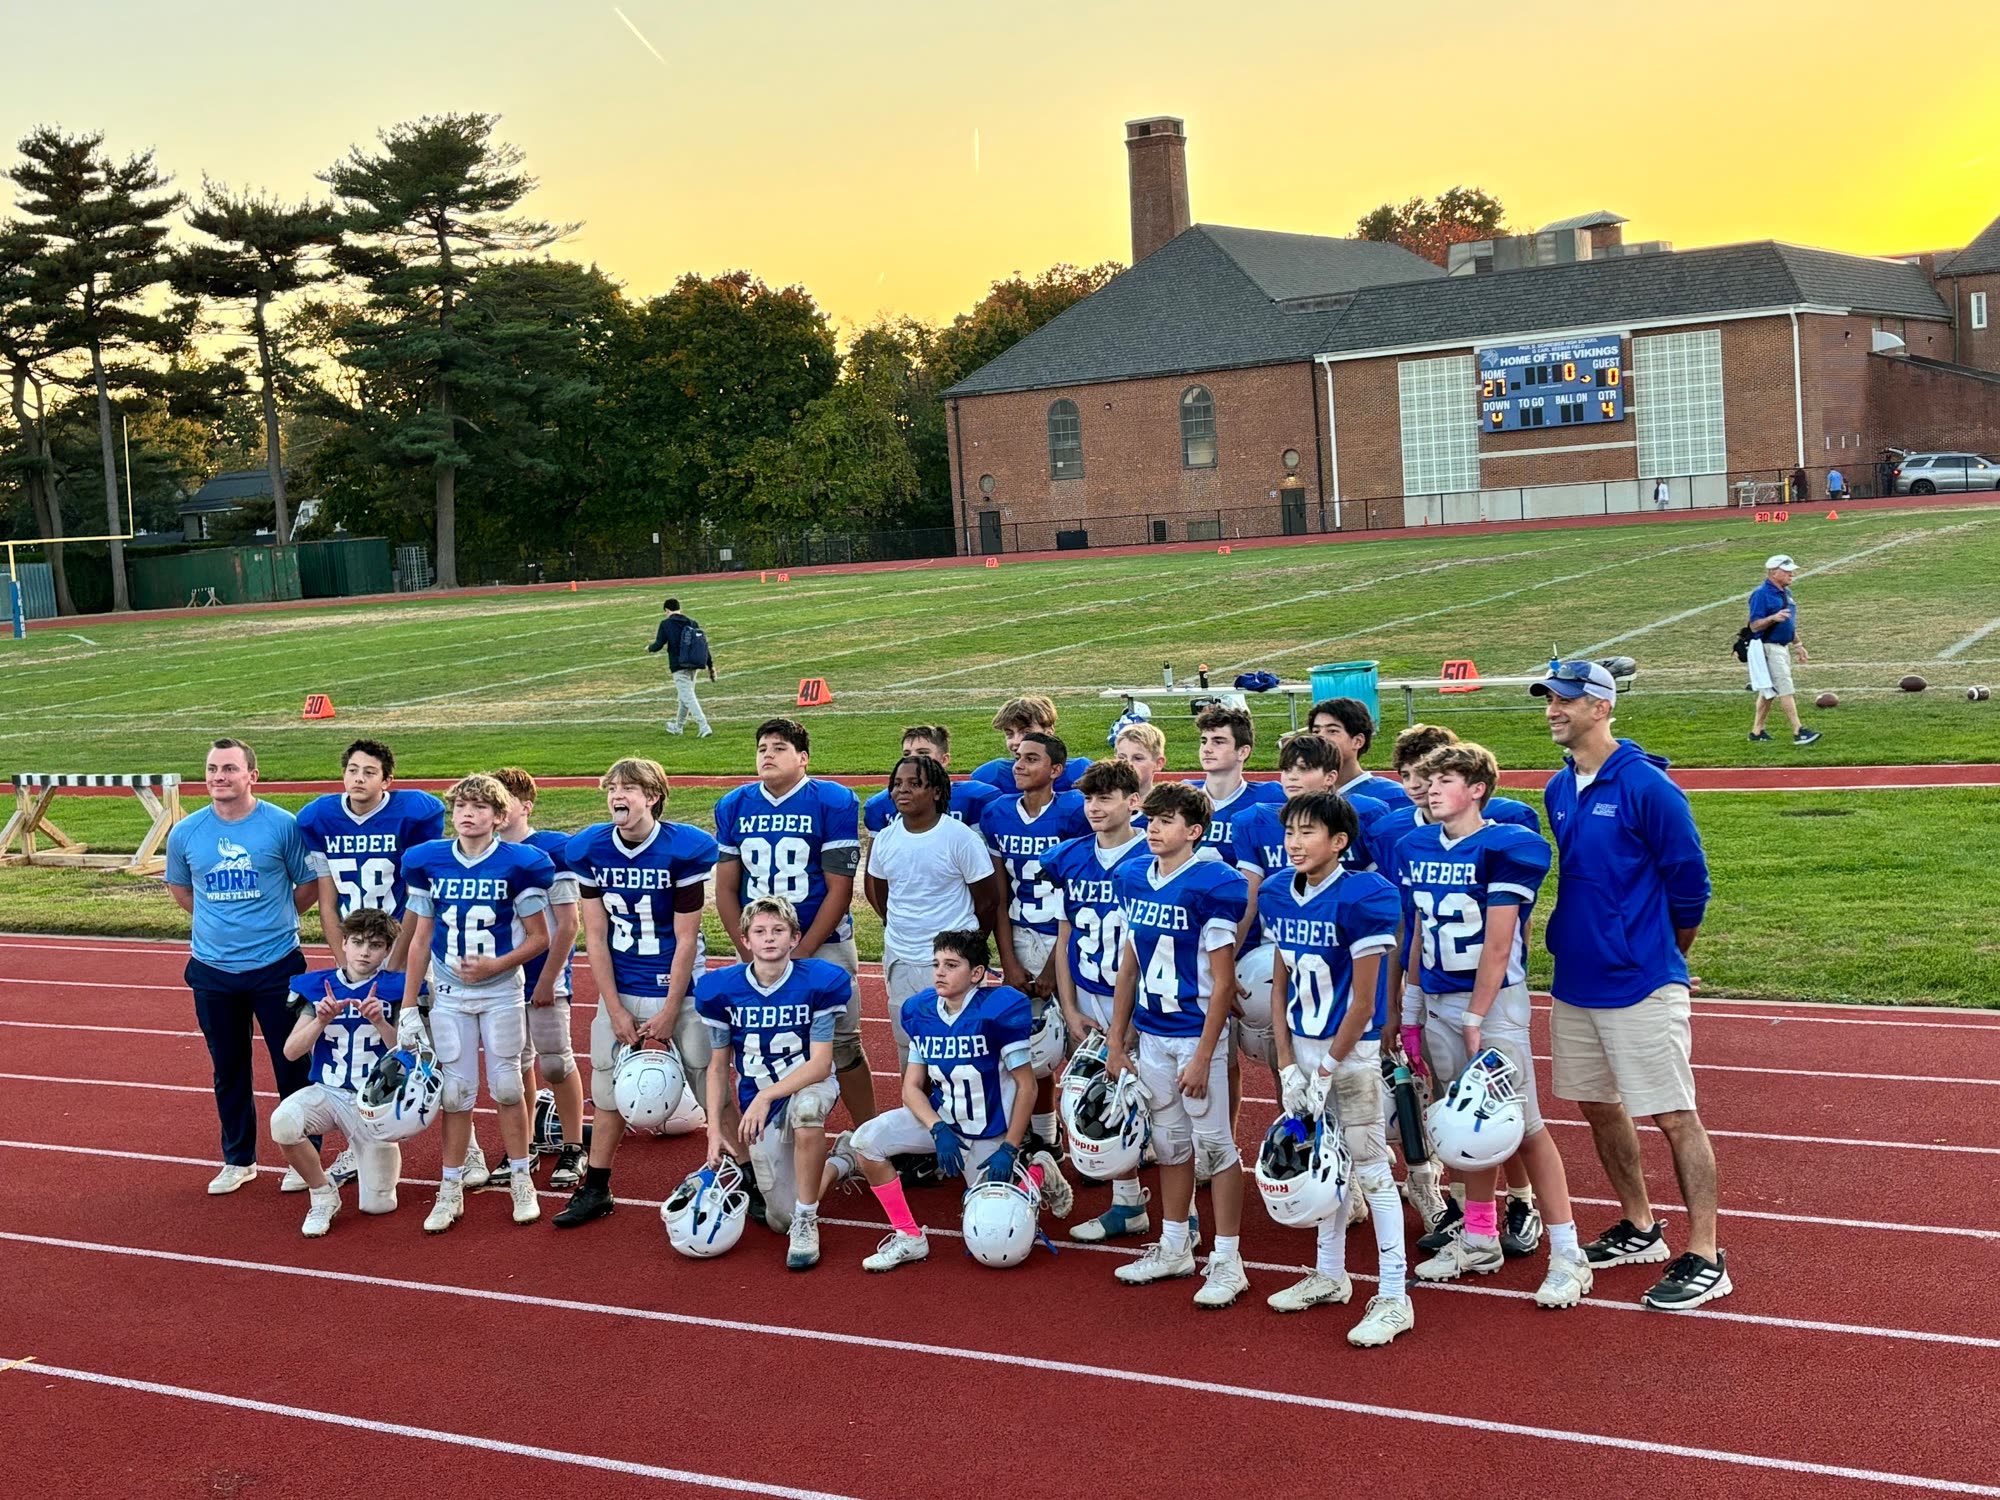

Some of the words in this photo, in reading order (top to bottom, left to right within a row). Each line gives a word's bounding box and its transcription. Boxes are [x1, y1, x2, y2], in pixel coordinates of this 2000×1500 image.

[1500, 355, 1531, 366] HOME
[1533, 353, 1547, 363] OF
[1549, 350, 1571, 361] THE
[1573, 346, 1619, 359] VIKINGS
[1592, 357, 1620, 369] GUEST
[1481, 369, 1507, 380] HOME
[1564, 362, 1576, 381] 0
[1607, 367, 1619, 386] 0
[1483, 379, 1506, 397] 27
[1597, 390, 1617, 401] QTR
[1483, 400, 1510, 411] DOWN
[1518, 398, 1530, 408] TO
[1531, 397, 1545, 407] GO
[1555, 395, 1574, 405] BALL
[1576, 393, 1588, 403] ON
[1775, 512, 1787, 521] 40
[1443, 663, 1468, 680] 50
[800, 680, 820, 701] 40
[304, 695, 325, 714] 30
[739, 814, 813, 834] WEBER
[325, 834, 397, 853] WEBER
[204, 868, 259, 892] PORT
[590, 867, 672, 890] WEBER
[1409, 860, 1478, 885] WEBER
[207, 889, 261, 901] WRESTLING
[327, 857, 398, 919] 58
[429, 877, 508, 900] WEBER
[1068, 879, 1120, 904] WEB
[603, 892, 661, 955] 61
[1267, 916, 1340, 947] WEBER
[441, 904, 497, 967] 16
[1075, 907, 1128, 987] 20
[725, 1004, 811, 1028] WEBER
[913, 1034, 989, 1059] WEBER
[321, 1023, 382, 1091] 36
[742, 1031, 806, 1090] 42
